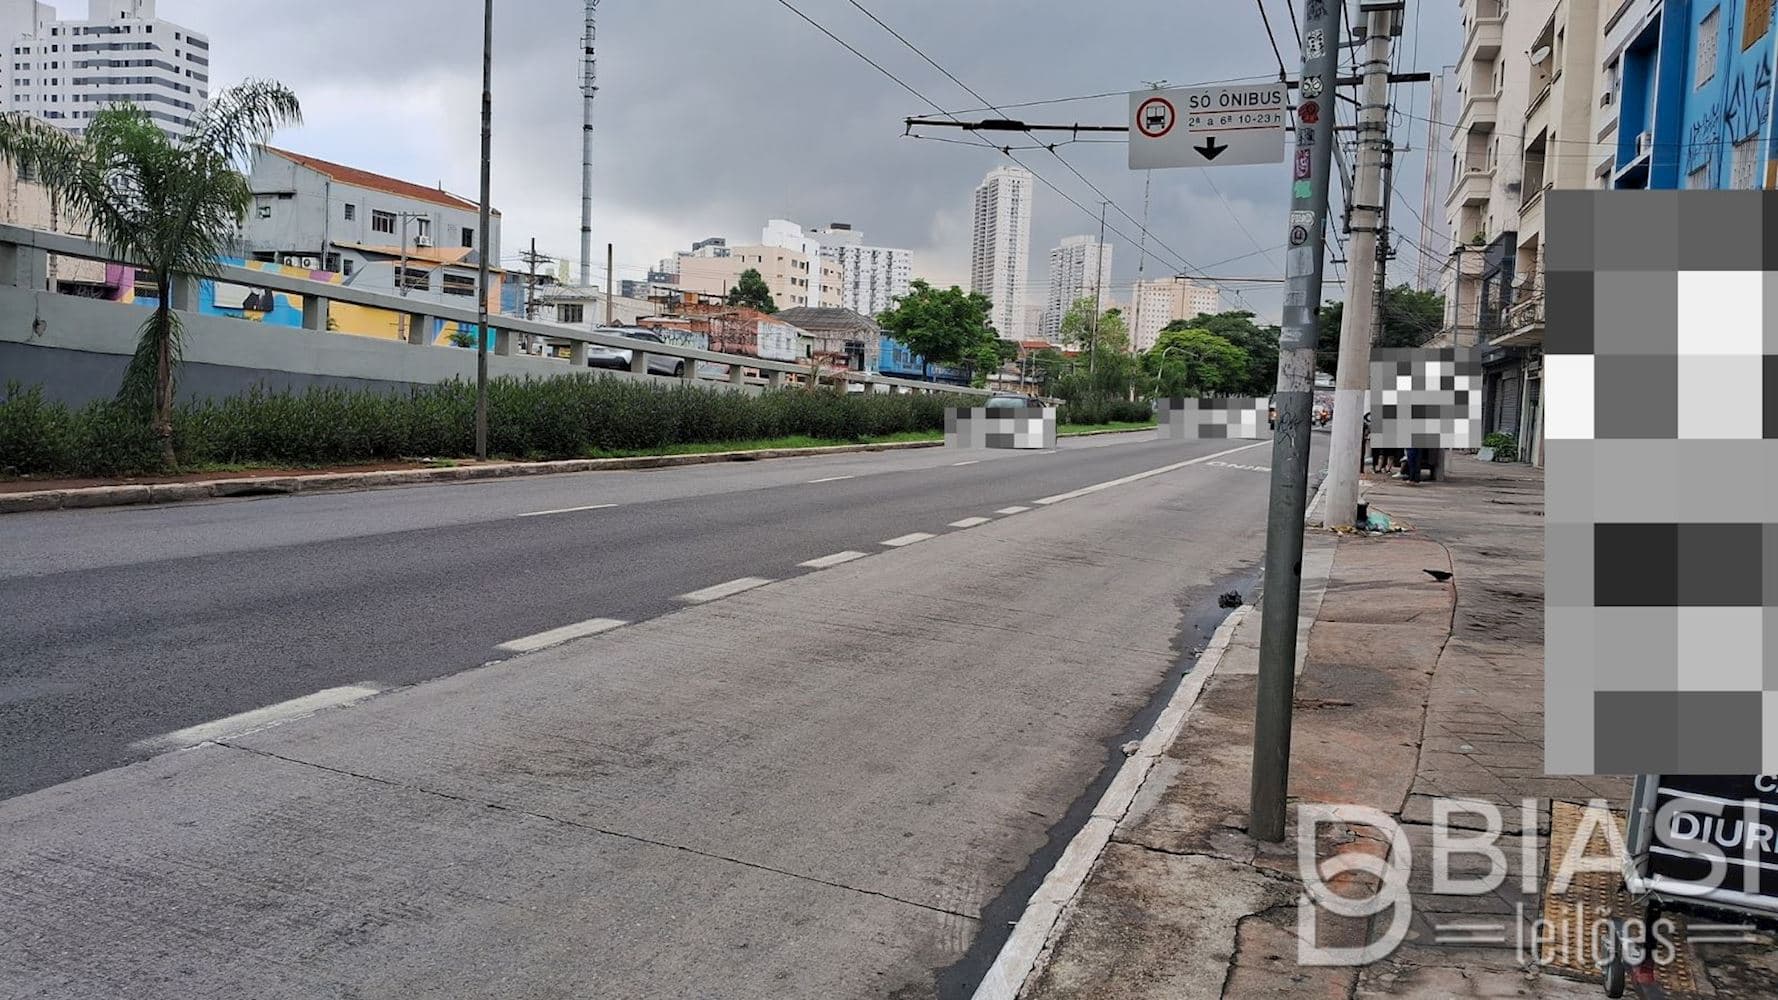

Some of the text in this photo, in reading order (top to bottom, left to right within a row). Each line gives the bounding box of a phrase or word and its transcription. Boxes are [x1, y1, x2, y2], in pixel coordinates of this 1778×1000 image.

[1189, 89, 1281, 109] SÓ ÔNIBUS
[1207, 117, 1214, 126] a
[1239, 113, 1271, 124] 10-23
[1754, 774, 1778, 793] C
[1670, 810, 1778, 854] DIUR
